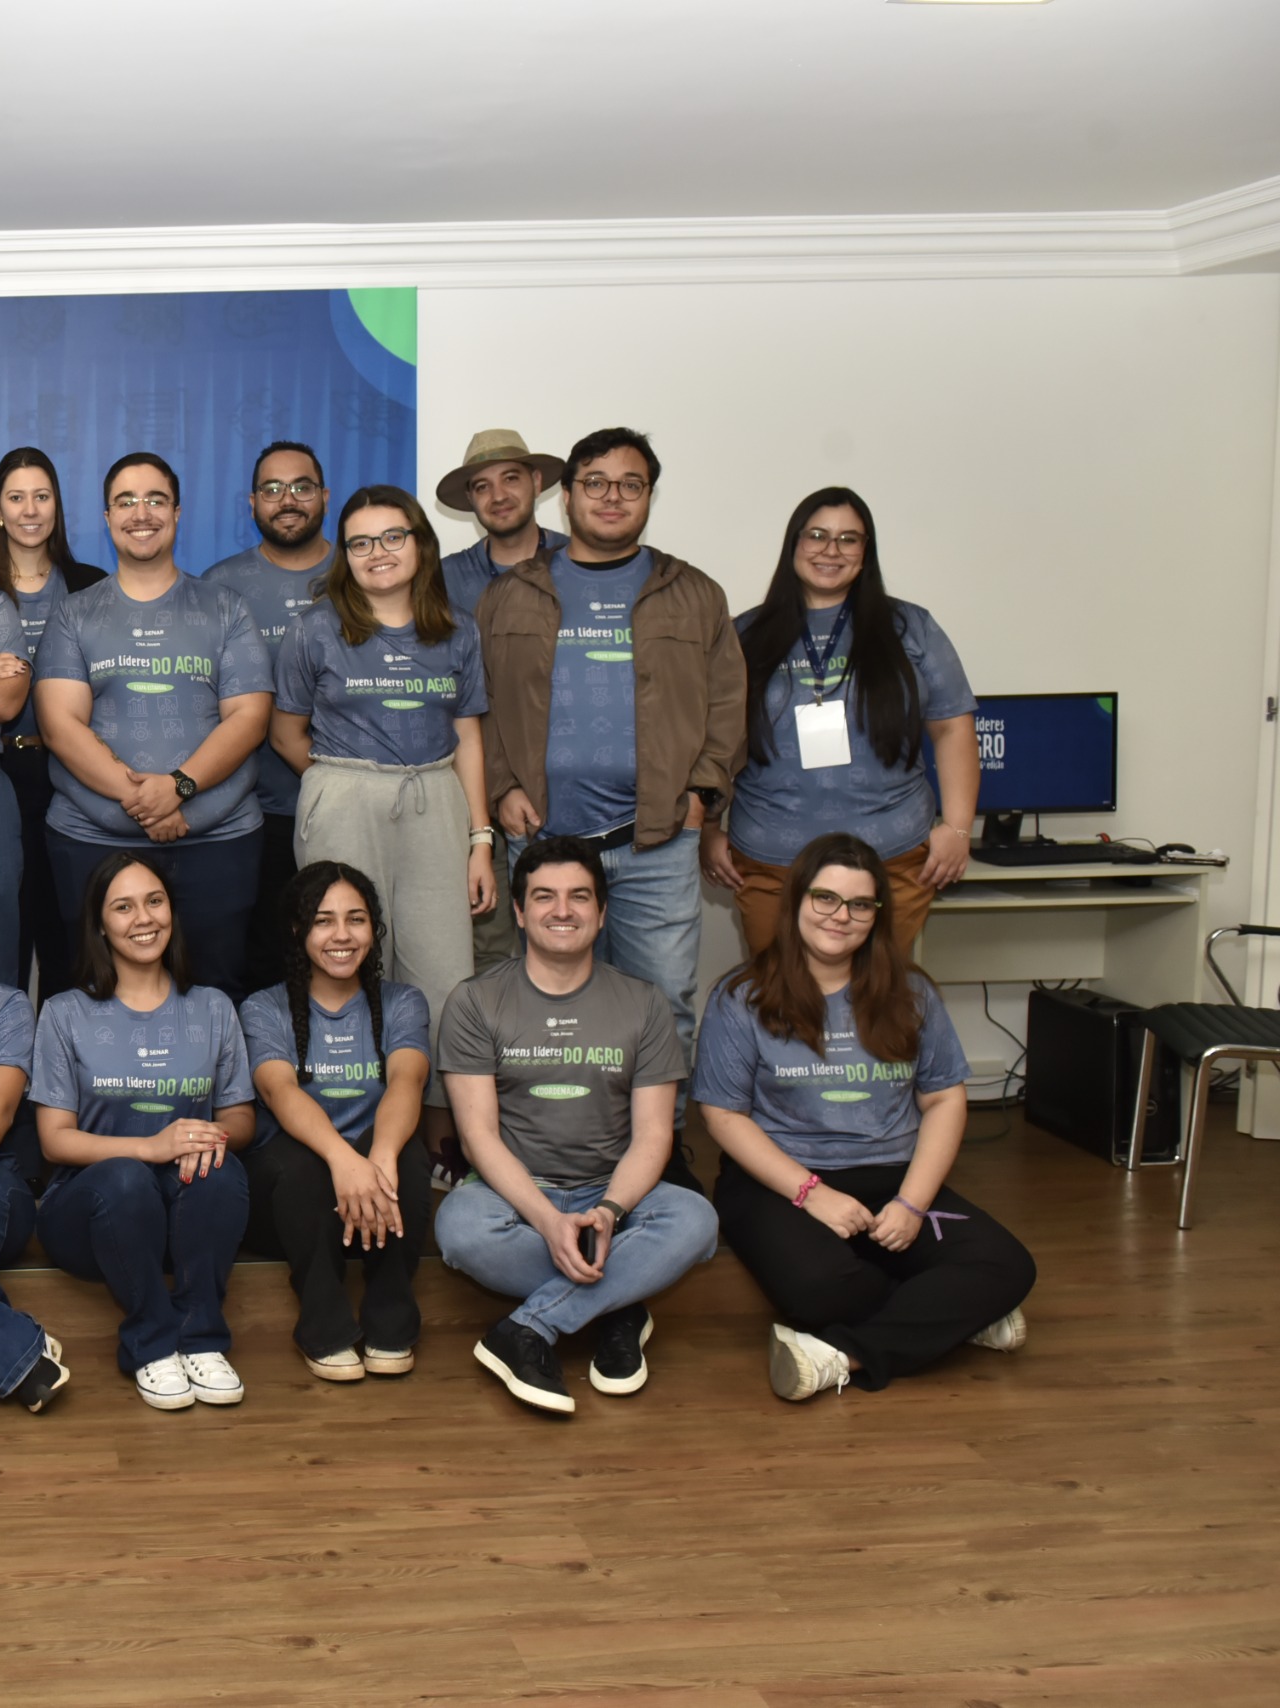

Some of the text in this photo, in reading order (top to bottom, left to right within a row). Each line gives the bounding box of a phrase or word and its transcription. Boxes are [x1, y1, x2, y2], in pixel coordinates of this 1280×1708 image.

[578, 626, 612, 638] Líderes
[90, 654, 213, 676] Jovens Líderes DO AGRO
[828, 655, 848, 671] DO
[345, 677, 457, 694] Jovens Líderes DO AGRO
[986, 760, 1005, 770] edição
[500, 1046, 624, 1066] Jovens Líderes DO AGRO
[315, 1062, 343, 1074] Líderes
[344, 1062, 364, 1081] DO
[775, 1064, 809, 1078] Jovens
[811, 1062, 844, 1076] Líderes
[845, 1063, 868, 1083] DO
[92, 1076, 213, 1097] Jovens Líderes DO AGRO
[535, 1085, 585, 1097] COORDENAÇÃO
